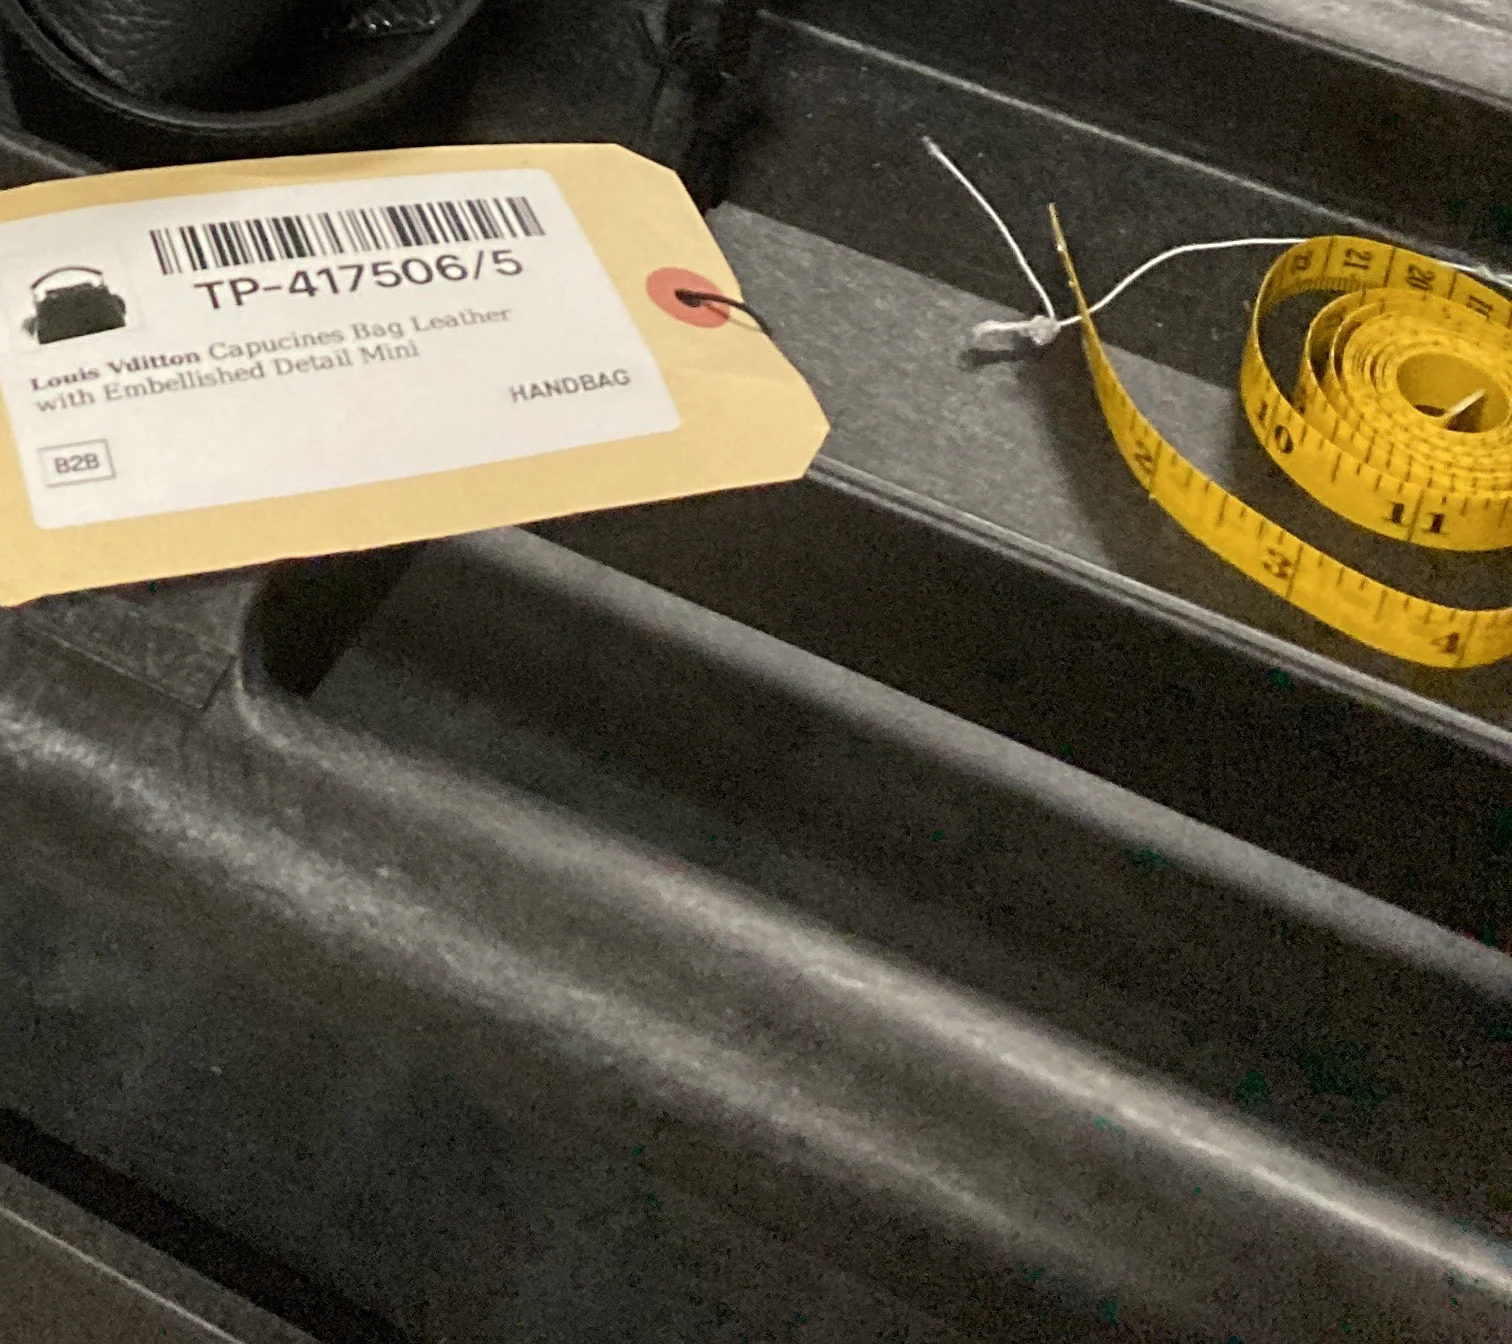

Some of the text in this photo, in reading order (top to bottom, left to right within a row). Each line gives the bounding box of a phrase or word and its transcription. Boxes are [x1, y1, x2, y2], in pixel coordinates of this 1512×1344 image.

[193, 248, 523, 311] TP-417506/5
[28, 365, 100, 393] Louis
[208, 327, 346, 362] Capucines
[351, 319, 405, 346] Bag
[412, 305, 512, 334] Leather
[35, 338, 420, 414] with Embellished Detail Mini
[508, 366, 633, 405] HANDBAG
[53, 450, 101, 477] B2B
[1431, 631, 1461, 655] 4
